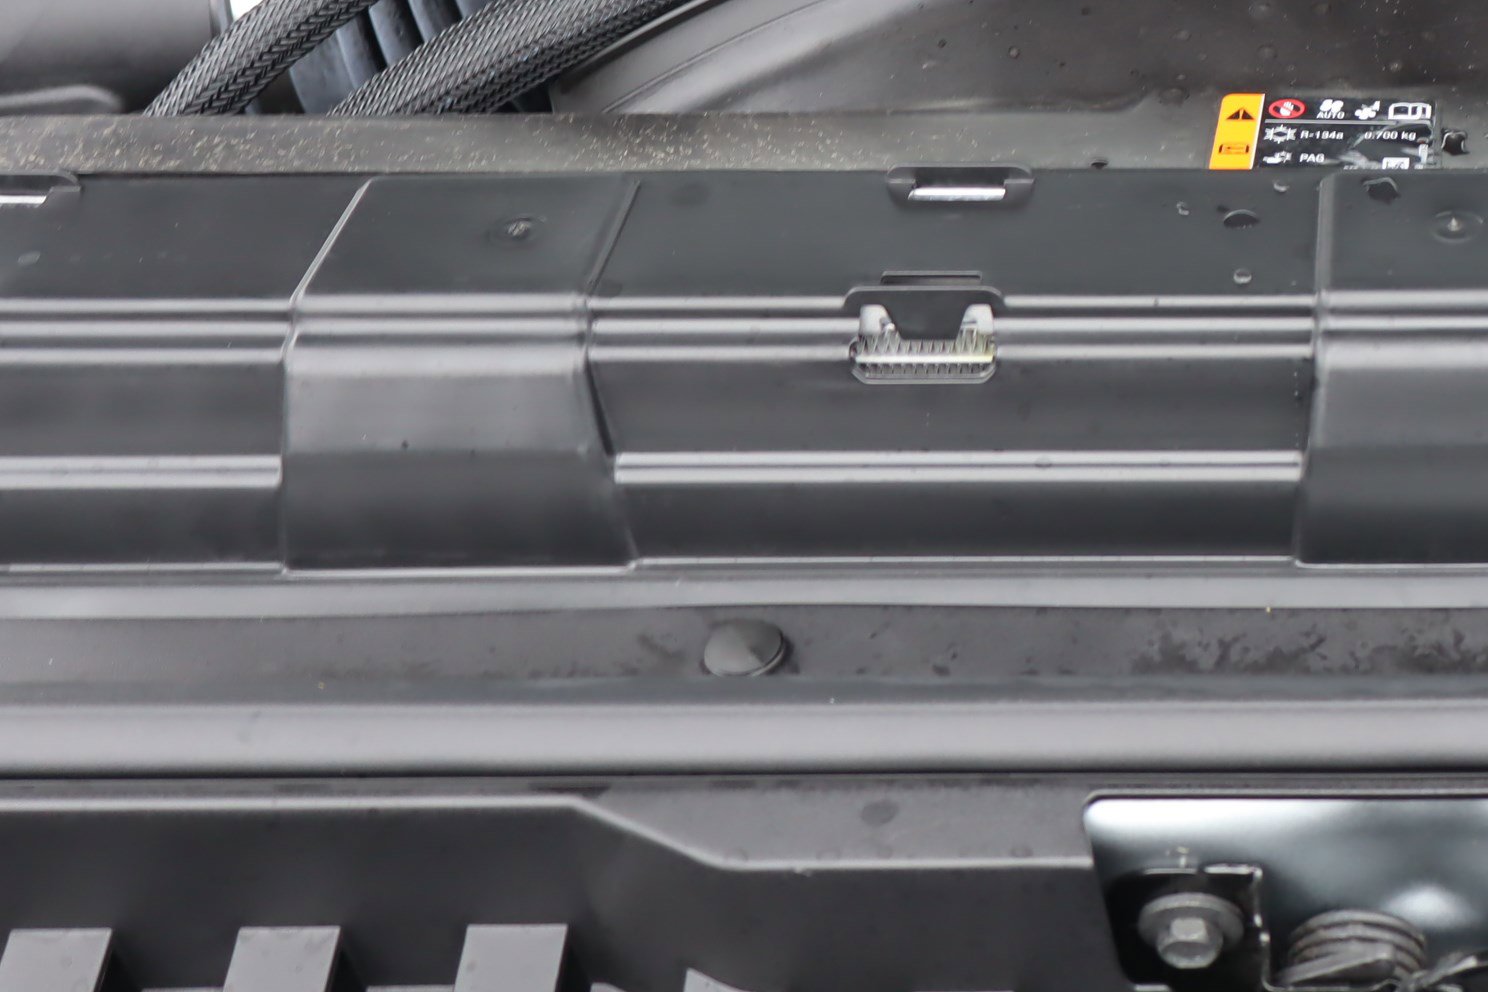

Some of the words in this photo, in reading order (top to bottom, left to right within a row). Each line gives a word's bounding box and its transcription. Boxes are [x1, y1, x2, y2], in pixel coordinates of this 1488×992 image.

[1316, 111, 1345, 120] AUTO
[1401, 130, 1417, 141] kg
[1299, 152, 1326, 163] PAG
